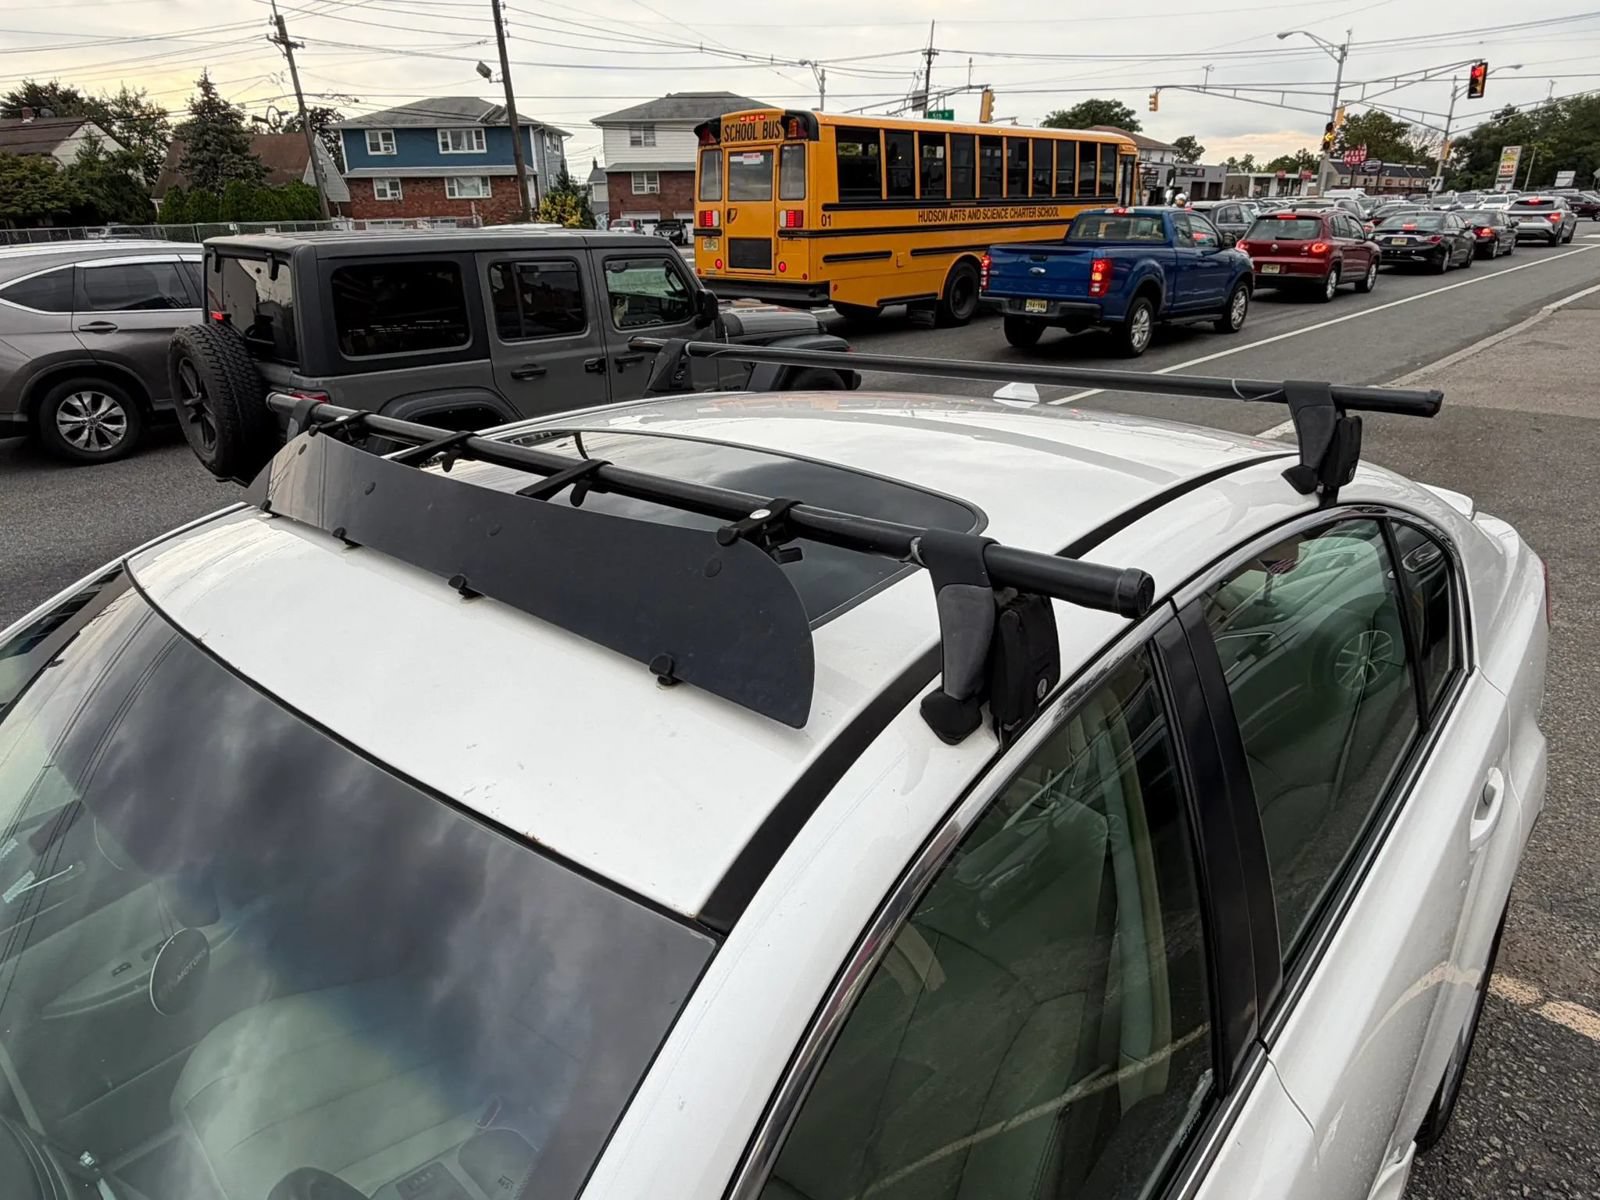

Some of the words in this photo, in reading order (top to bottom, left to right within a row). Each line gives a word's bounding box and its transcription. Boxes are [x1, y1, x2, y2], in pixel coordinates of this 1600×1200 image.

[724, 122, 757, 142] SCHOOL
[762, 120, 781, 139] BUS
[821, 214, 832, 227] 01
[918, 208, 948, 223] HUDSON
[950, 208, 966, 222] ARTS
[968, 208, 982, 220] AND
[982, 207, 1009, 220] SCIENCE
[1009, 207, 1036, 219] CHARTER
[1037, 206, 1059, 218] SCHOOL
